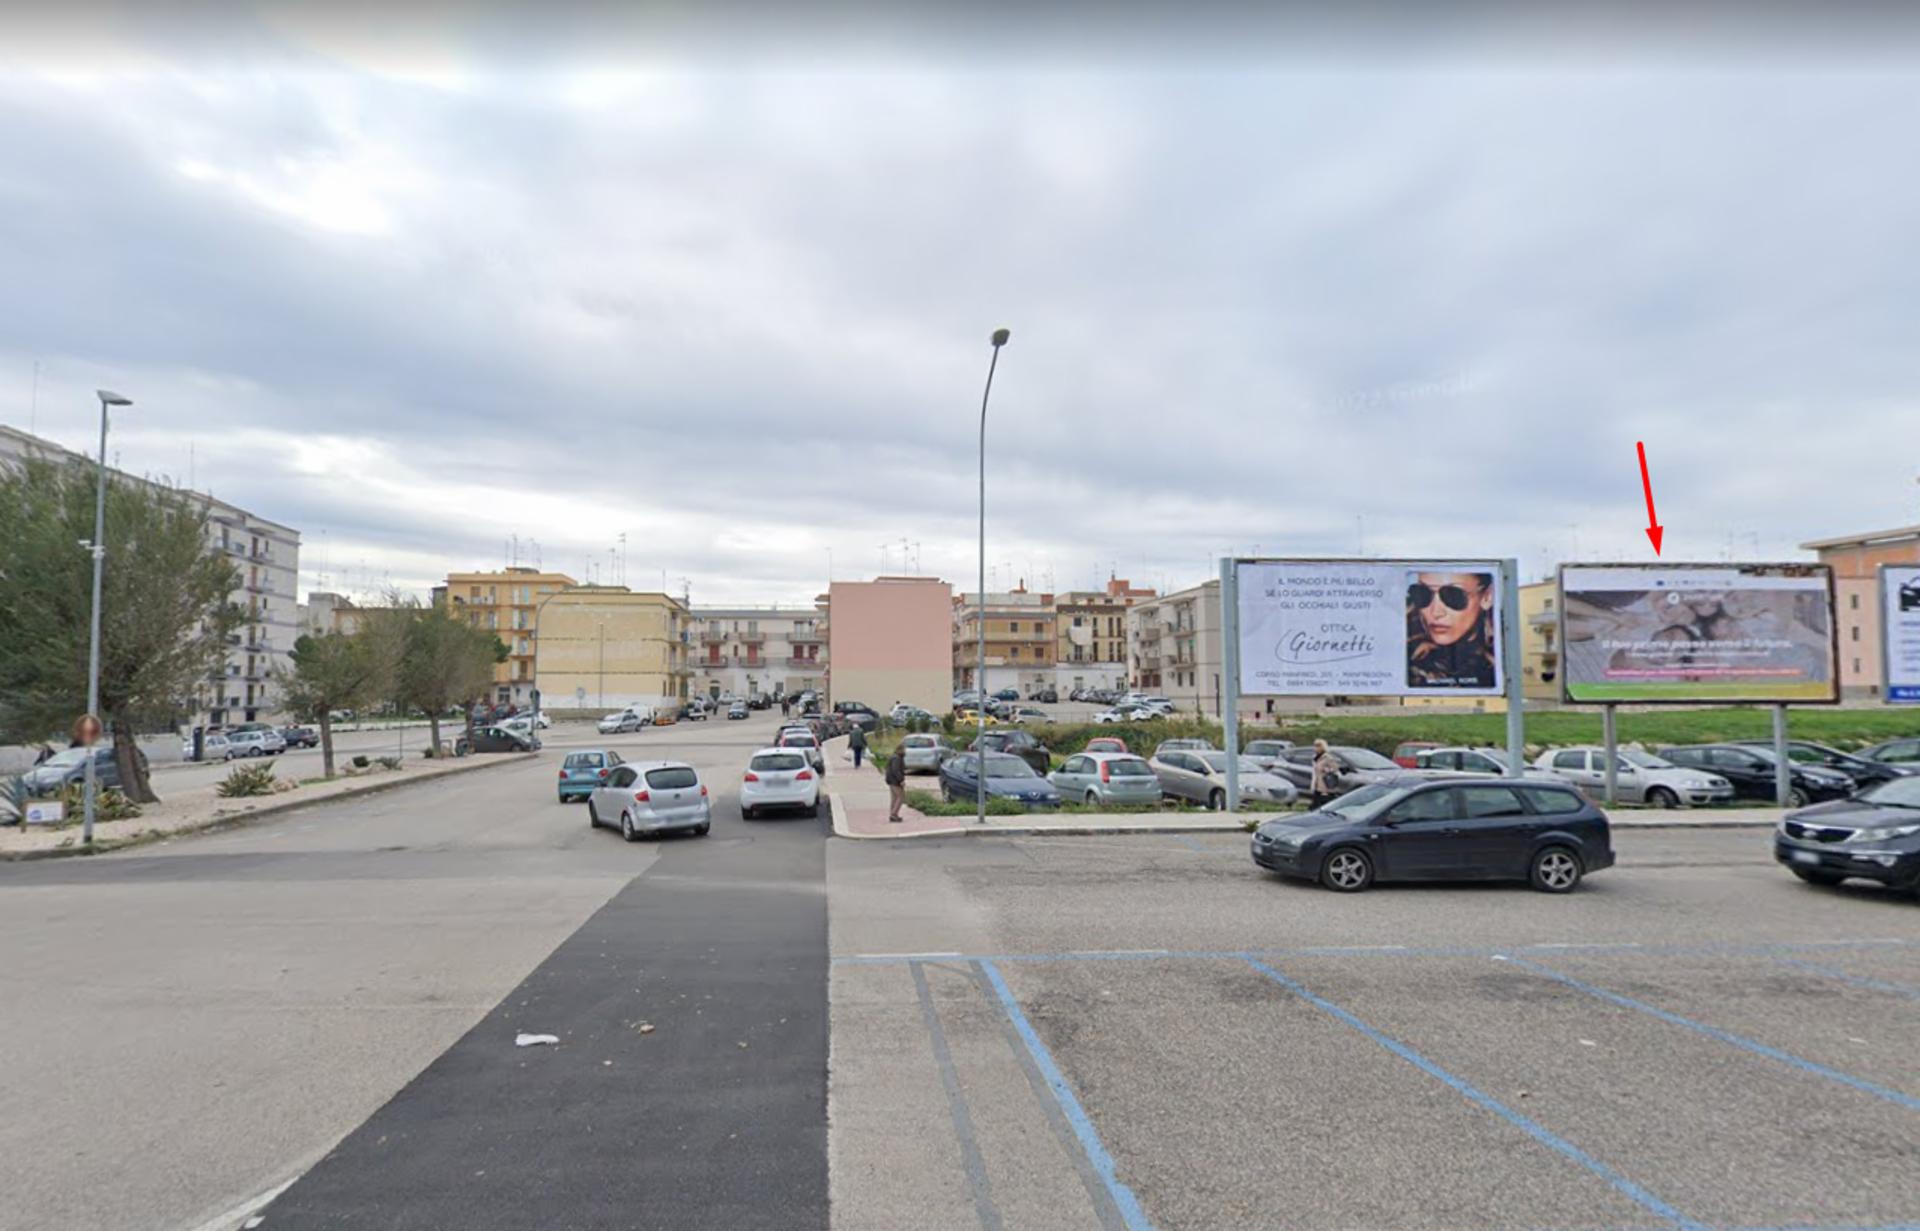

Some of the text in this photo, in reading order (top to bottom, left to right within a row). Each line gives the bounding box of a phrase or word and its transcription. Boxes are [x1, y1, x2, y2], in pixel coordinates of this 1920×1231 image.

[1287, 577, 1321, 585] MONDO
[1345, 577, 1375, 585] BELLO
[1278, 588, 1290, 597] LO
[1291, 589, 1324, 598] GUARDI
[1326, 588, 1383, 598] ATTRAVERSO
[1280, 600, 1371, 609] GLI OCCHIALI GIUSTI
[1320, 623, 1357, 633] OTTICA
[1288, 630, 1375, 661] Giornetti
